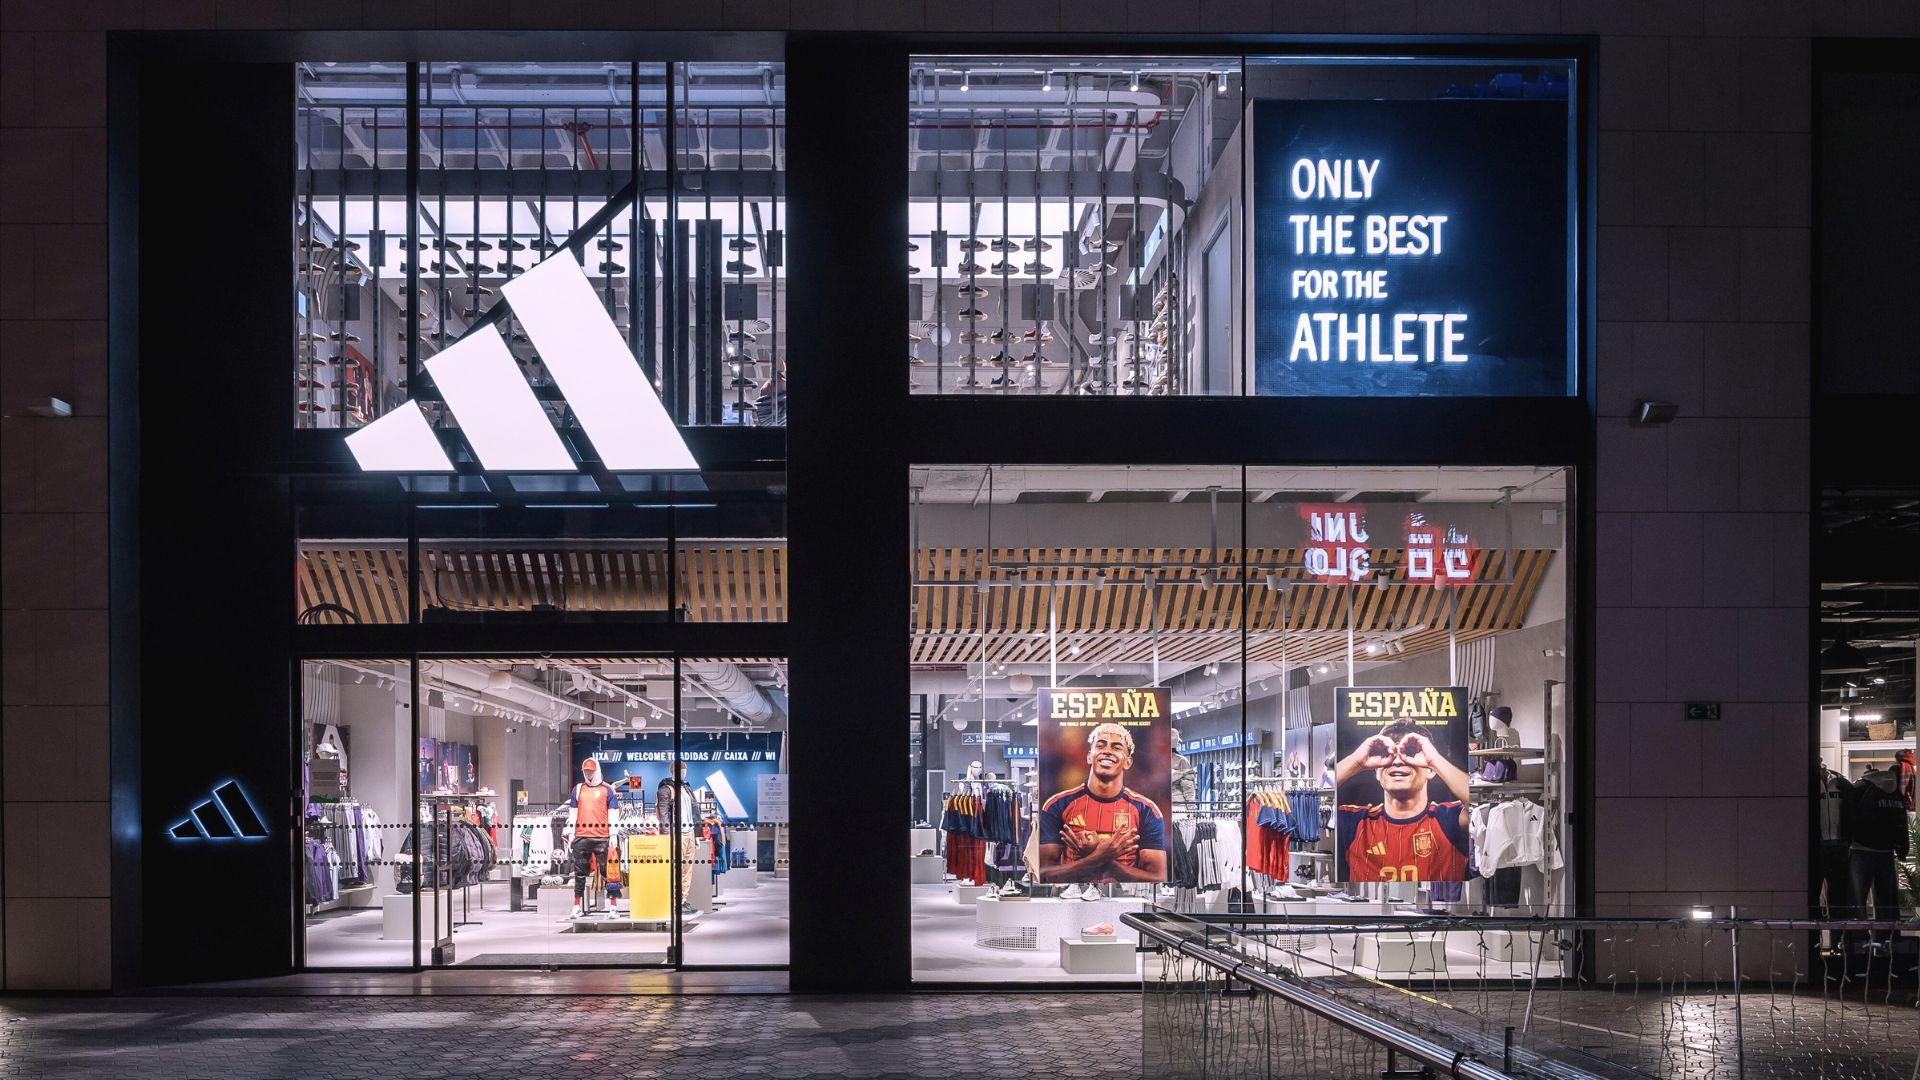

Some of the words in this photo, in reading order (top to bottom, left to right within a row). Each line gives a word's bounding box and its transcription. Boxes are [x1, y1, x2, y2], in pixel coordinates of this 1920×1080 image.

[1291, 158, 1380, 199] ONLY
[1289, 215, 1356, 255] THE
[1366, 214, 1448, 255] BEST
[1292, 270, 1339, 299] FOR
[1341, 270, 1388, 299] THE
[1289, 312, 1468, 363] ATHLETE
[1050, 688, 1160, 719] ESPAÑA
[1348, 687, 1457, 717] ESPAÑA
[626, 752, 666, 761] WELCOME
[680, 752, 709, 761] ADIDAS
[724, 752, 748, 761] CAIXA
[1007, 747, 1024, 756] EVO
